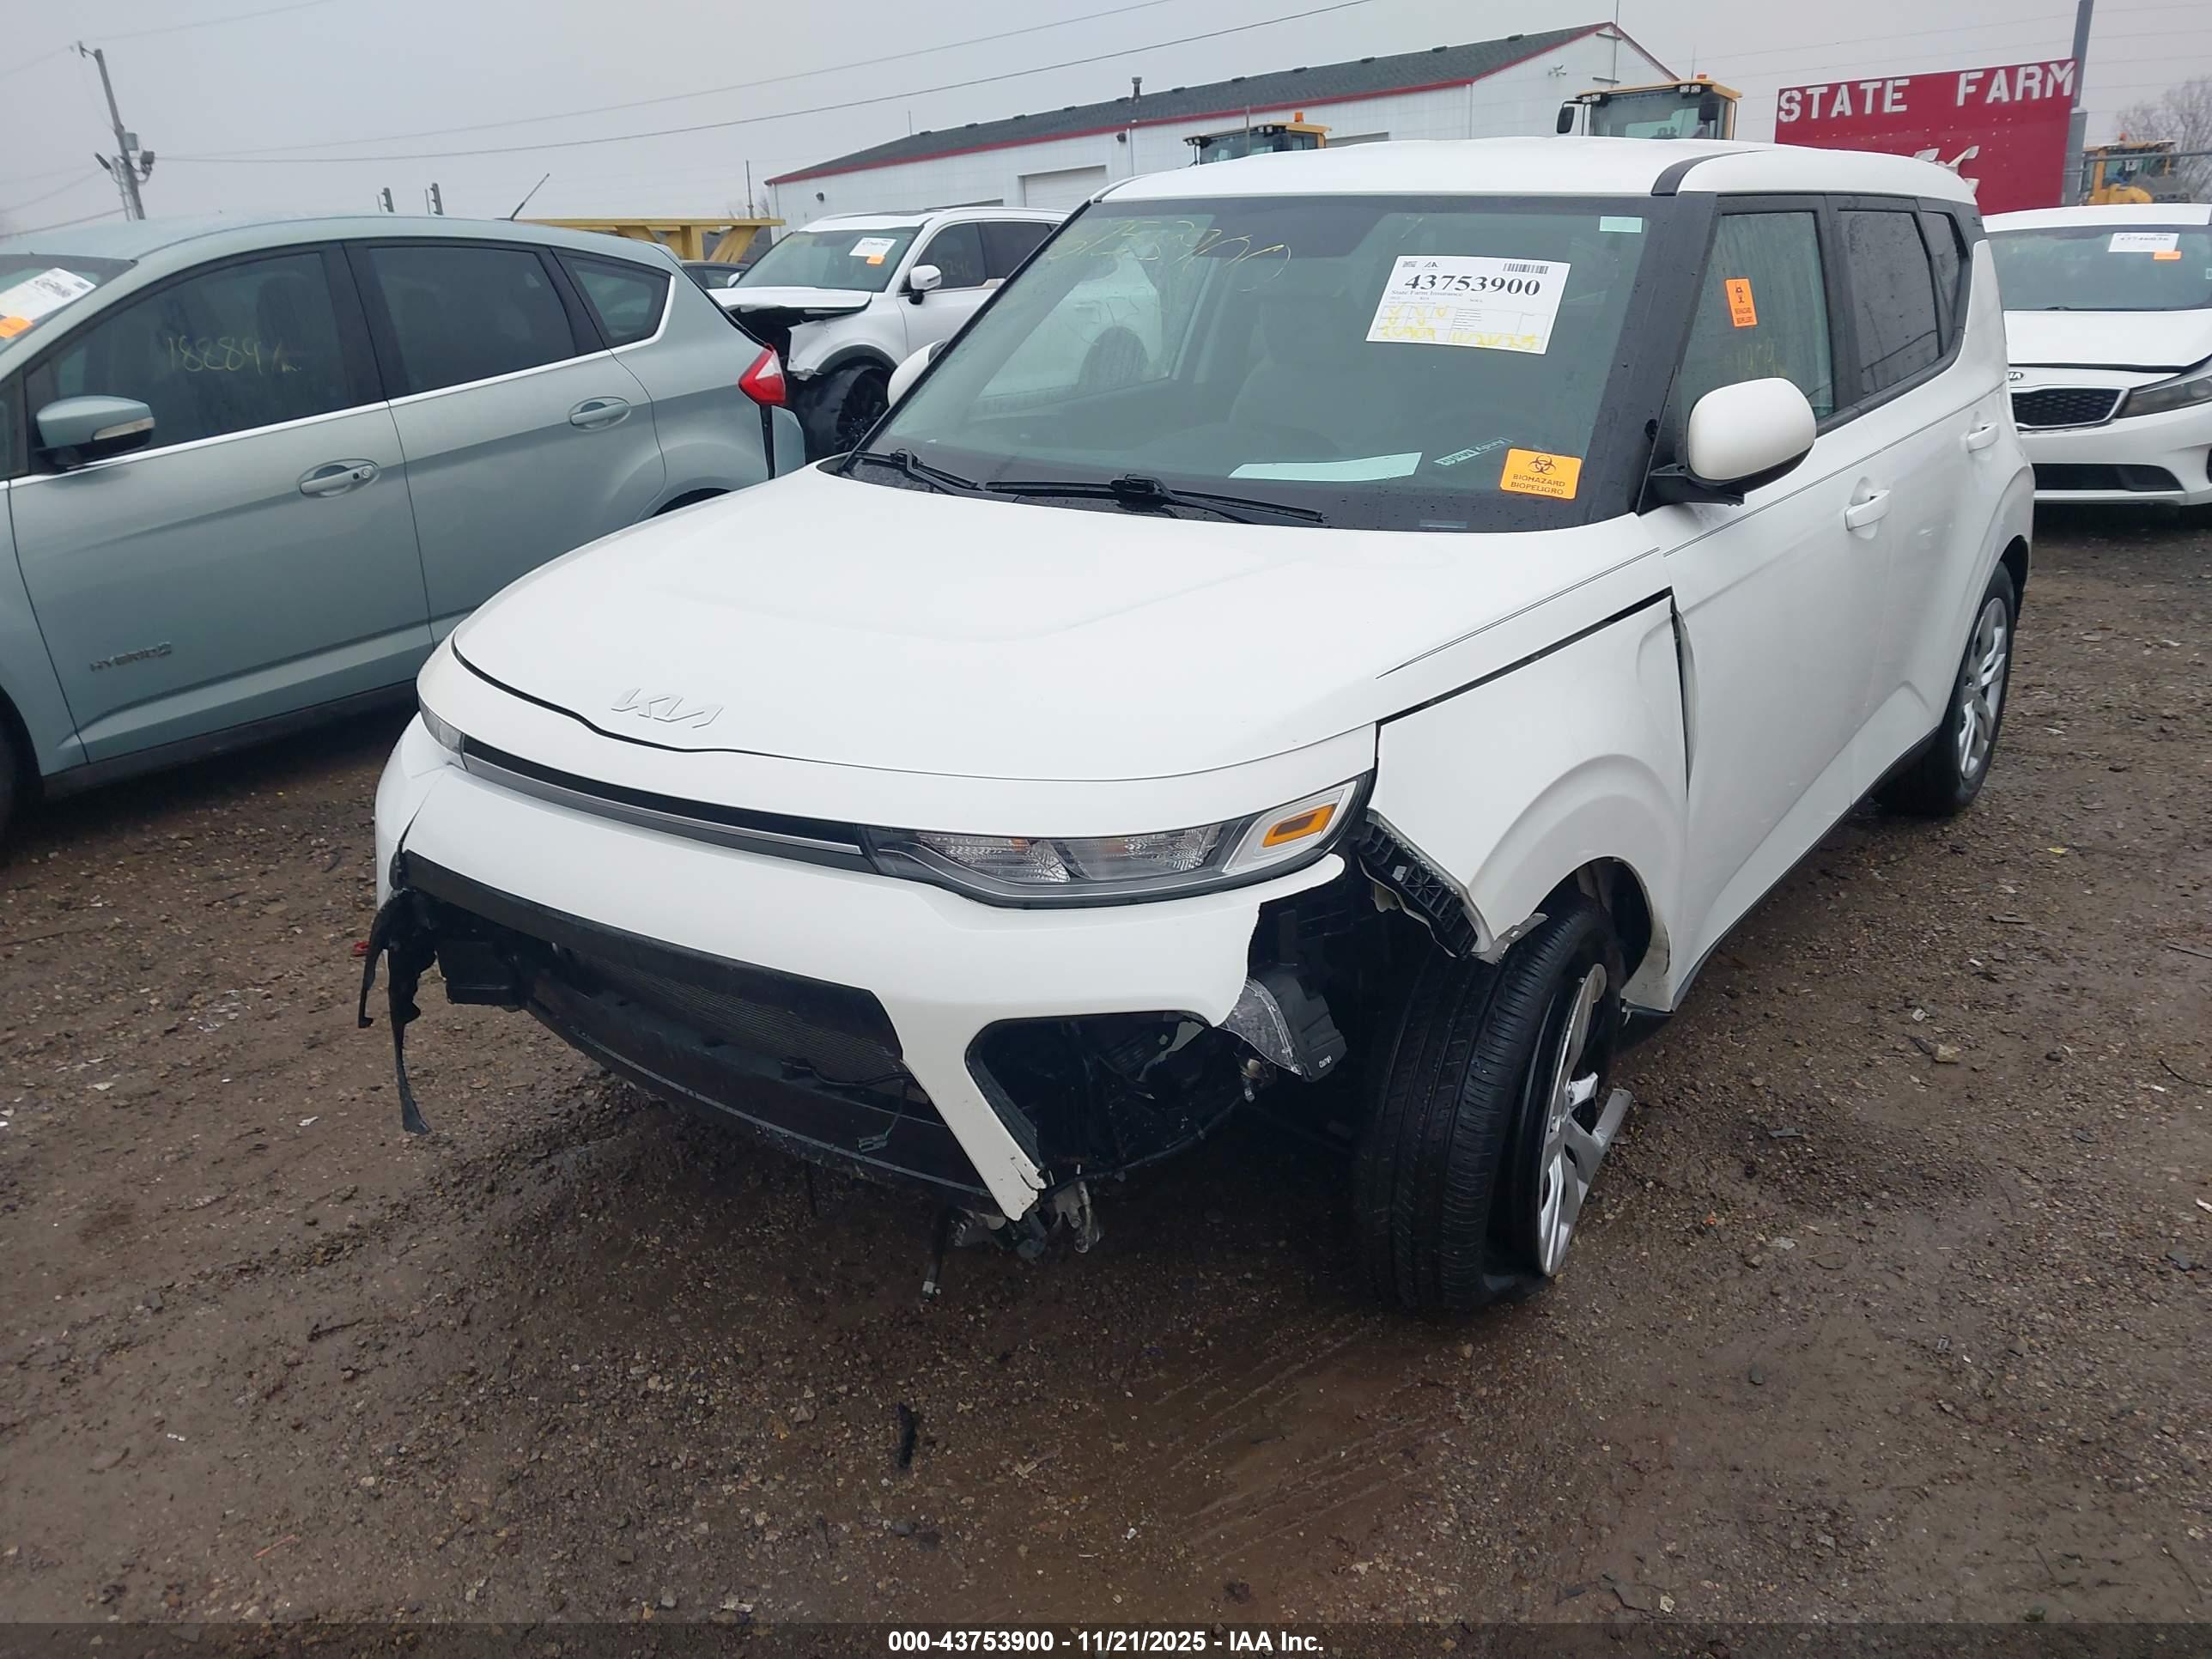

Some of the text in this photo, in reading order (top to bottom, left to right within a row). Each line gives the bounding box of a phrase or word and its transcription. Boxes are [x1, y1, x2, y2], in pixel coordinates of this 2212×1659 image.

[1778, 61, 2075, 123] STATE FARM
[1404, 274, 1541, 296] 43753900
[1510, 482, 1564, 495] BIOPELIGRO
[1512, 473, 1566, 488] BIOHAZARD
[611, 687, 725, 729] KIA
